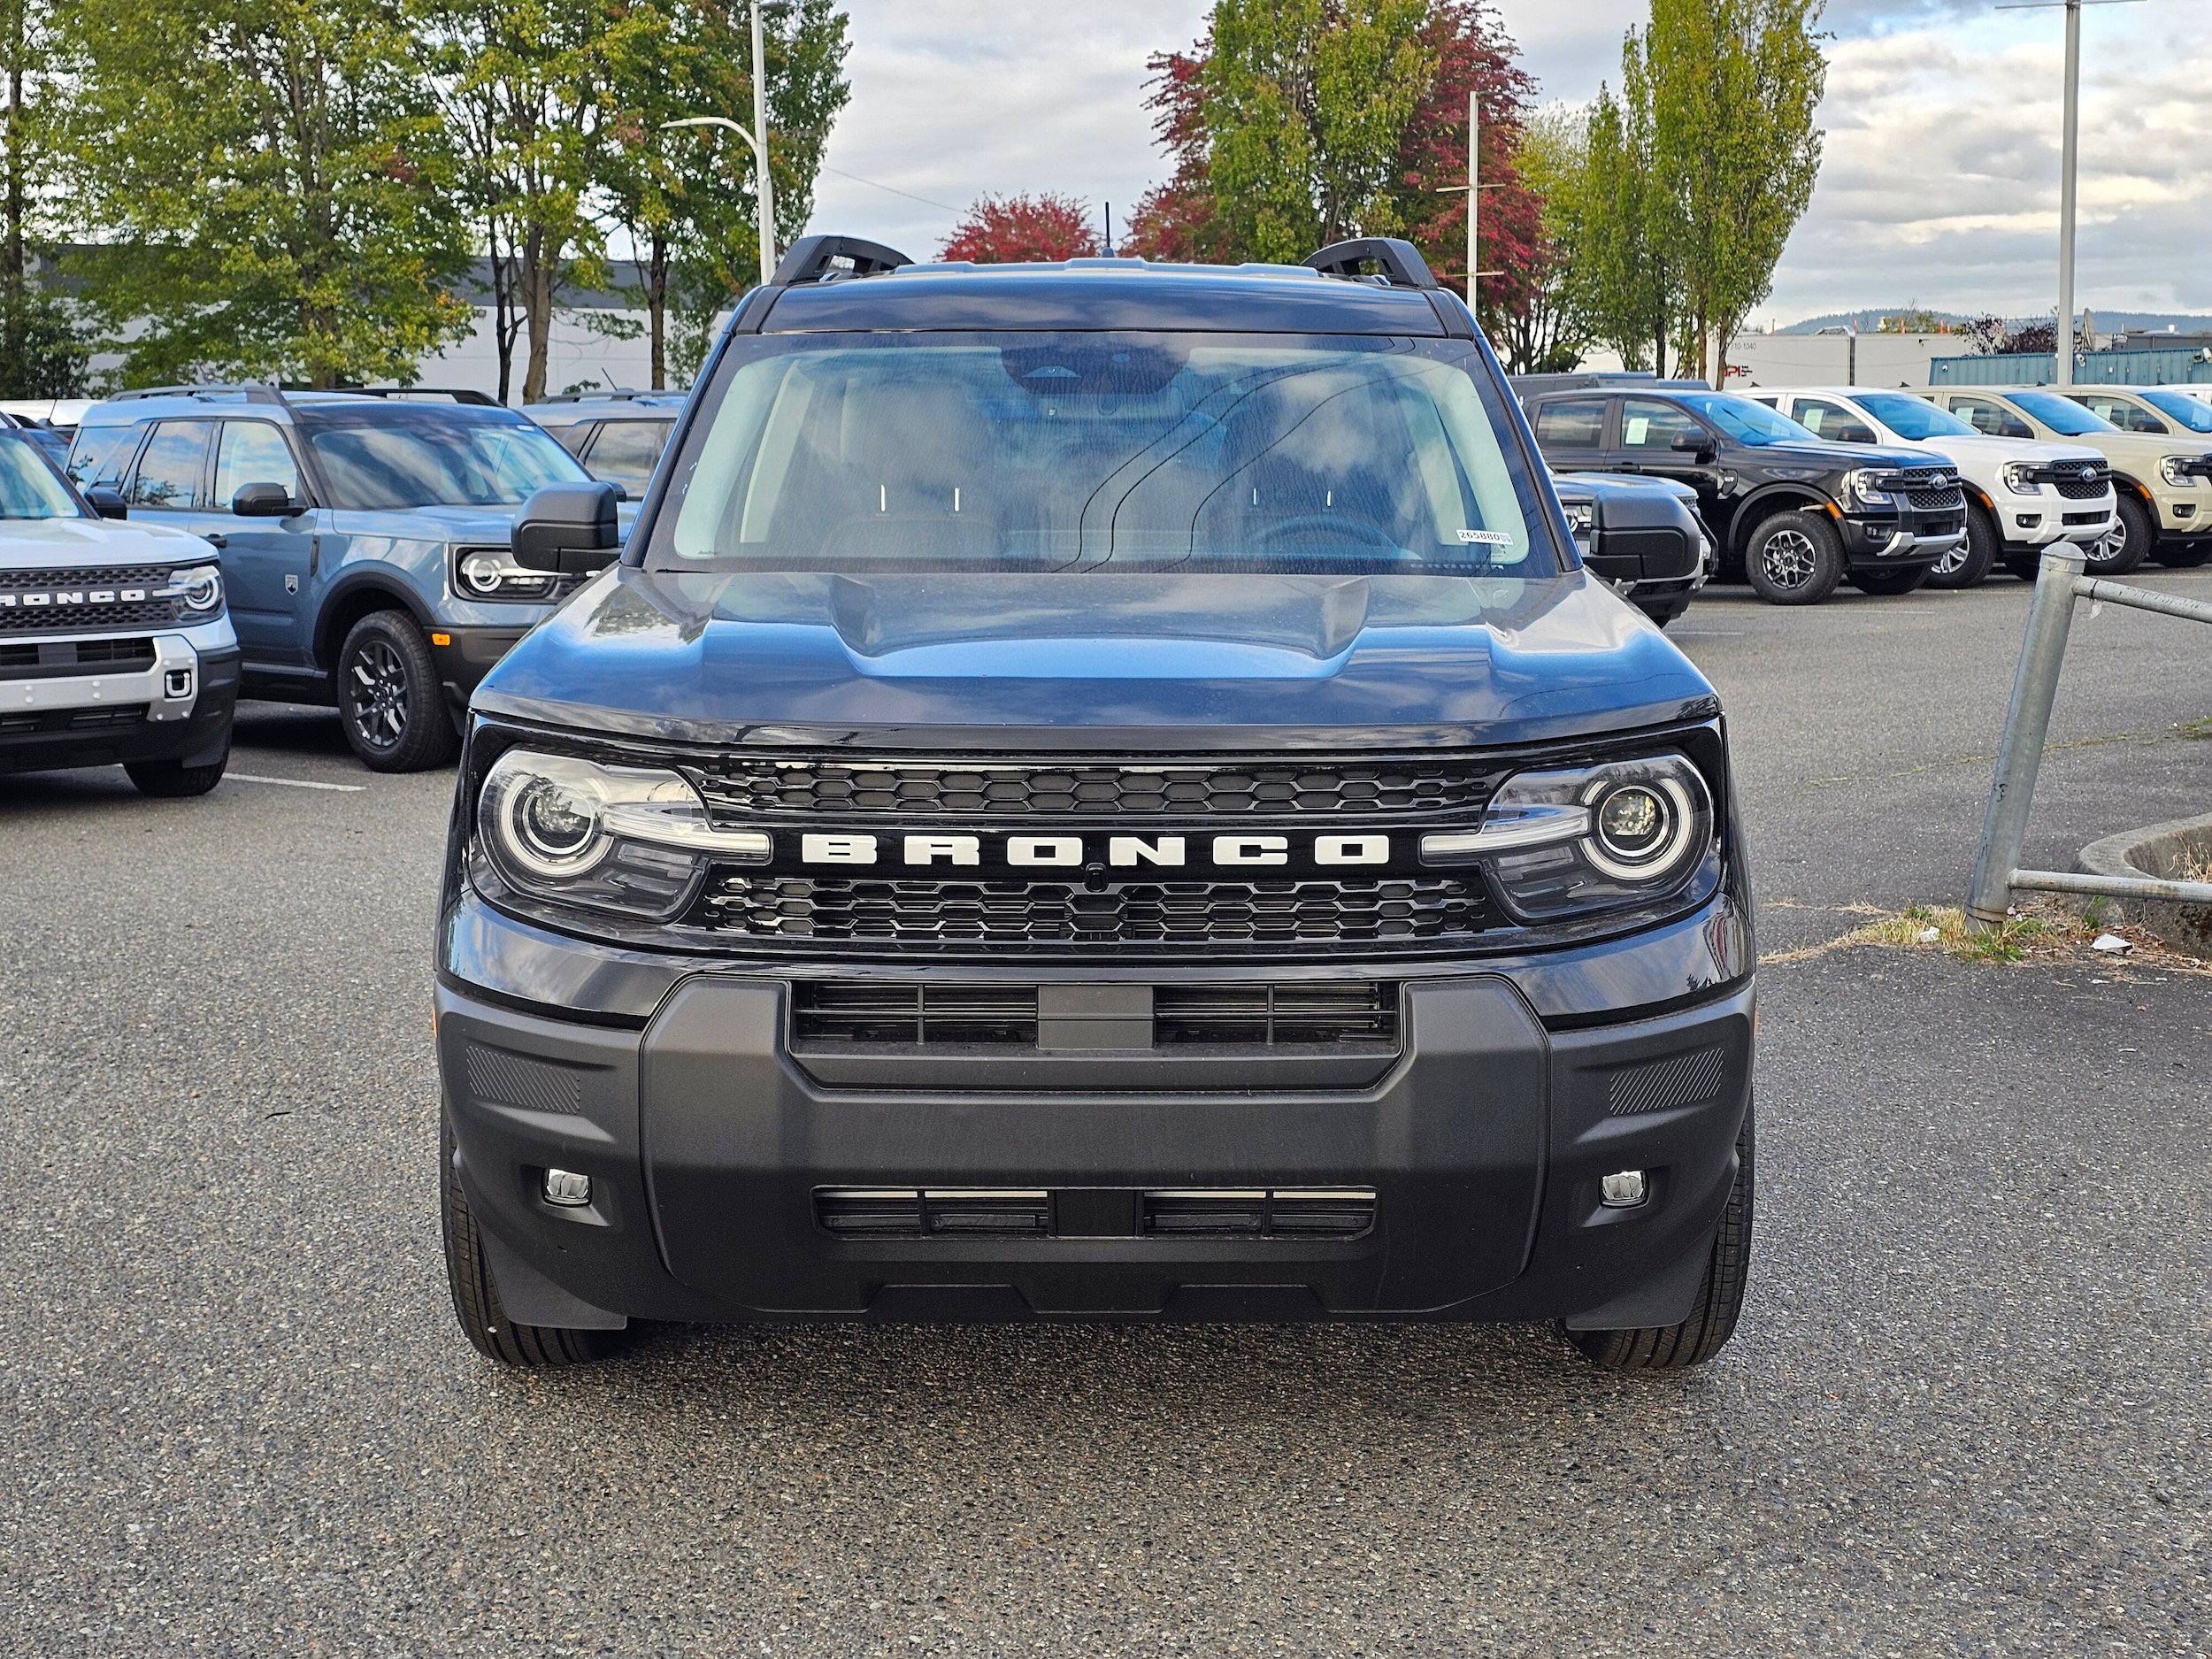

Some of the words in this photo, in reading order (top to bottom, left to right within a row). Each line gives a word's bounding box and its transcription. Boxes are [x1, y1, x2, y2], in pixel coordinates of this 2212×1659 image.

[1459, 531, 1501, 541] 265880
[0, 589, 146, 607] RONCO
[802, 833, 1390, 866] BRONCO
